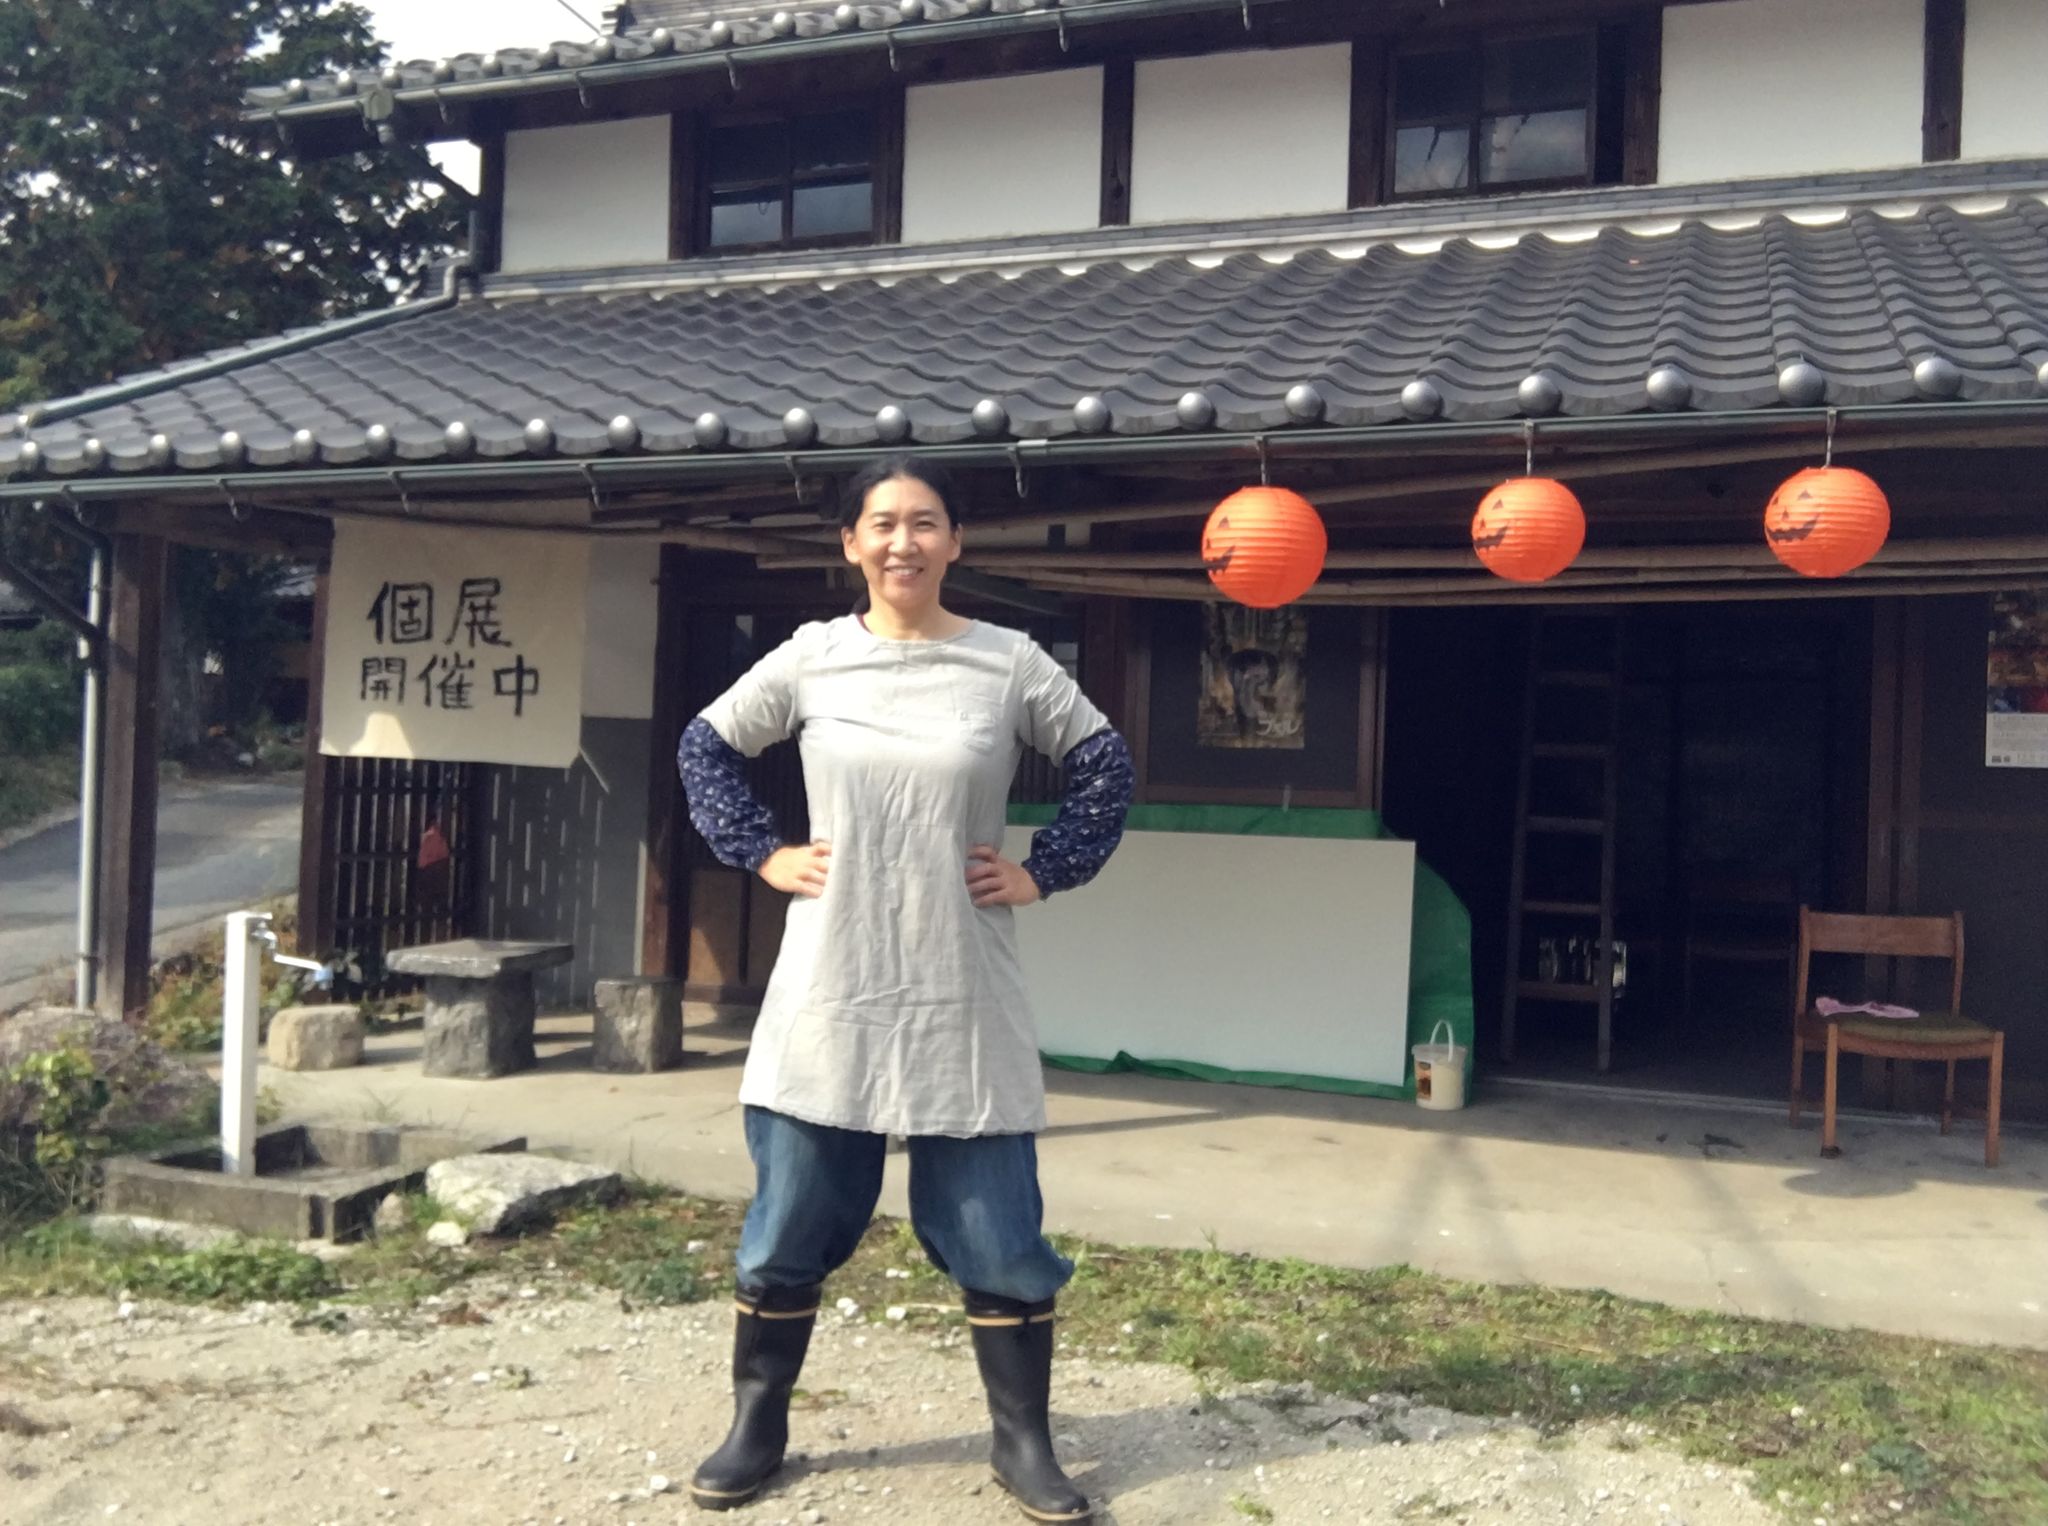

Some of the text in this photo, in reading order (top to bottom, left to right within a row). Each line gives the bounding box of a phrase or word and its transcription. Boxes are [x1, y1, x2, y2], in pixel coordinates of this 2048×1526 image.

[367, 577, 512, 647] 個展
[361, 652, 539, 716] 開催中
